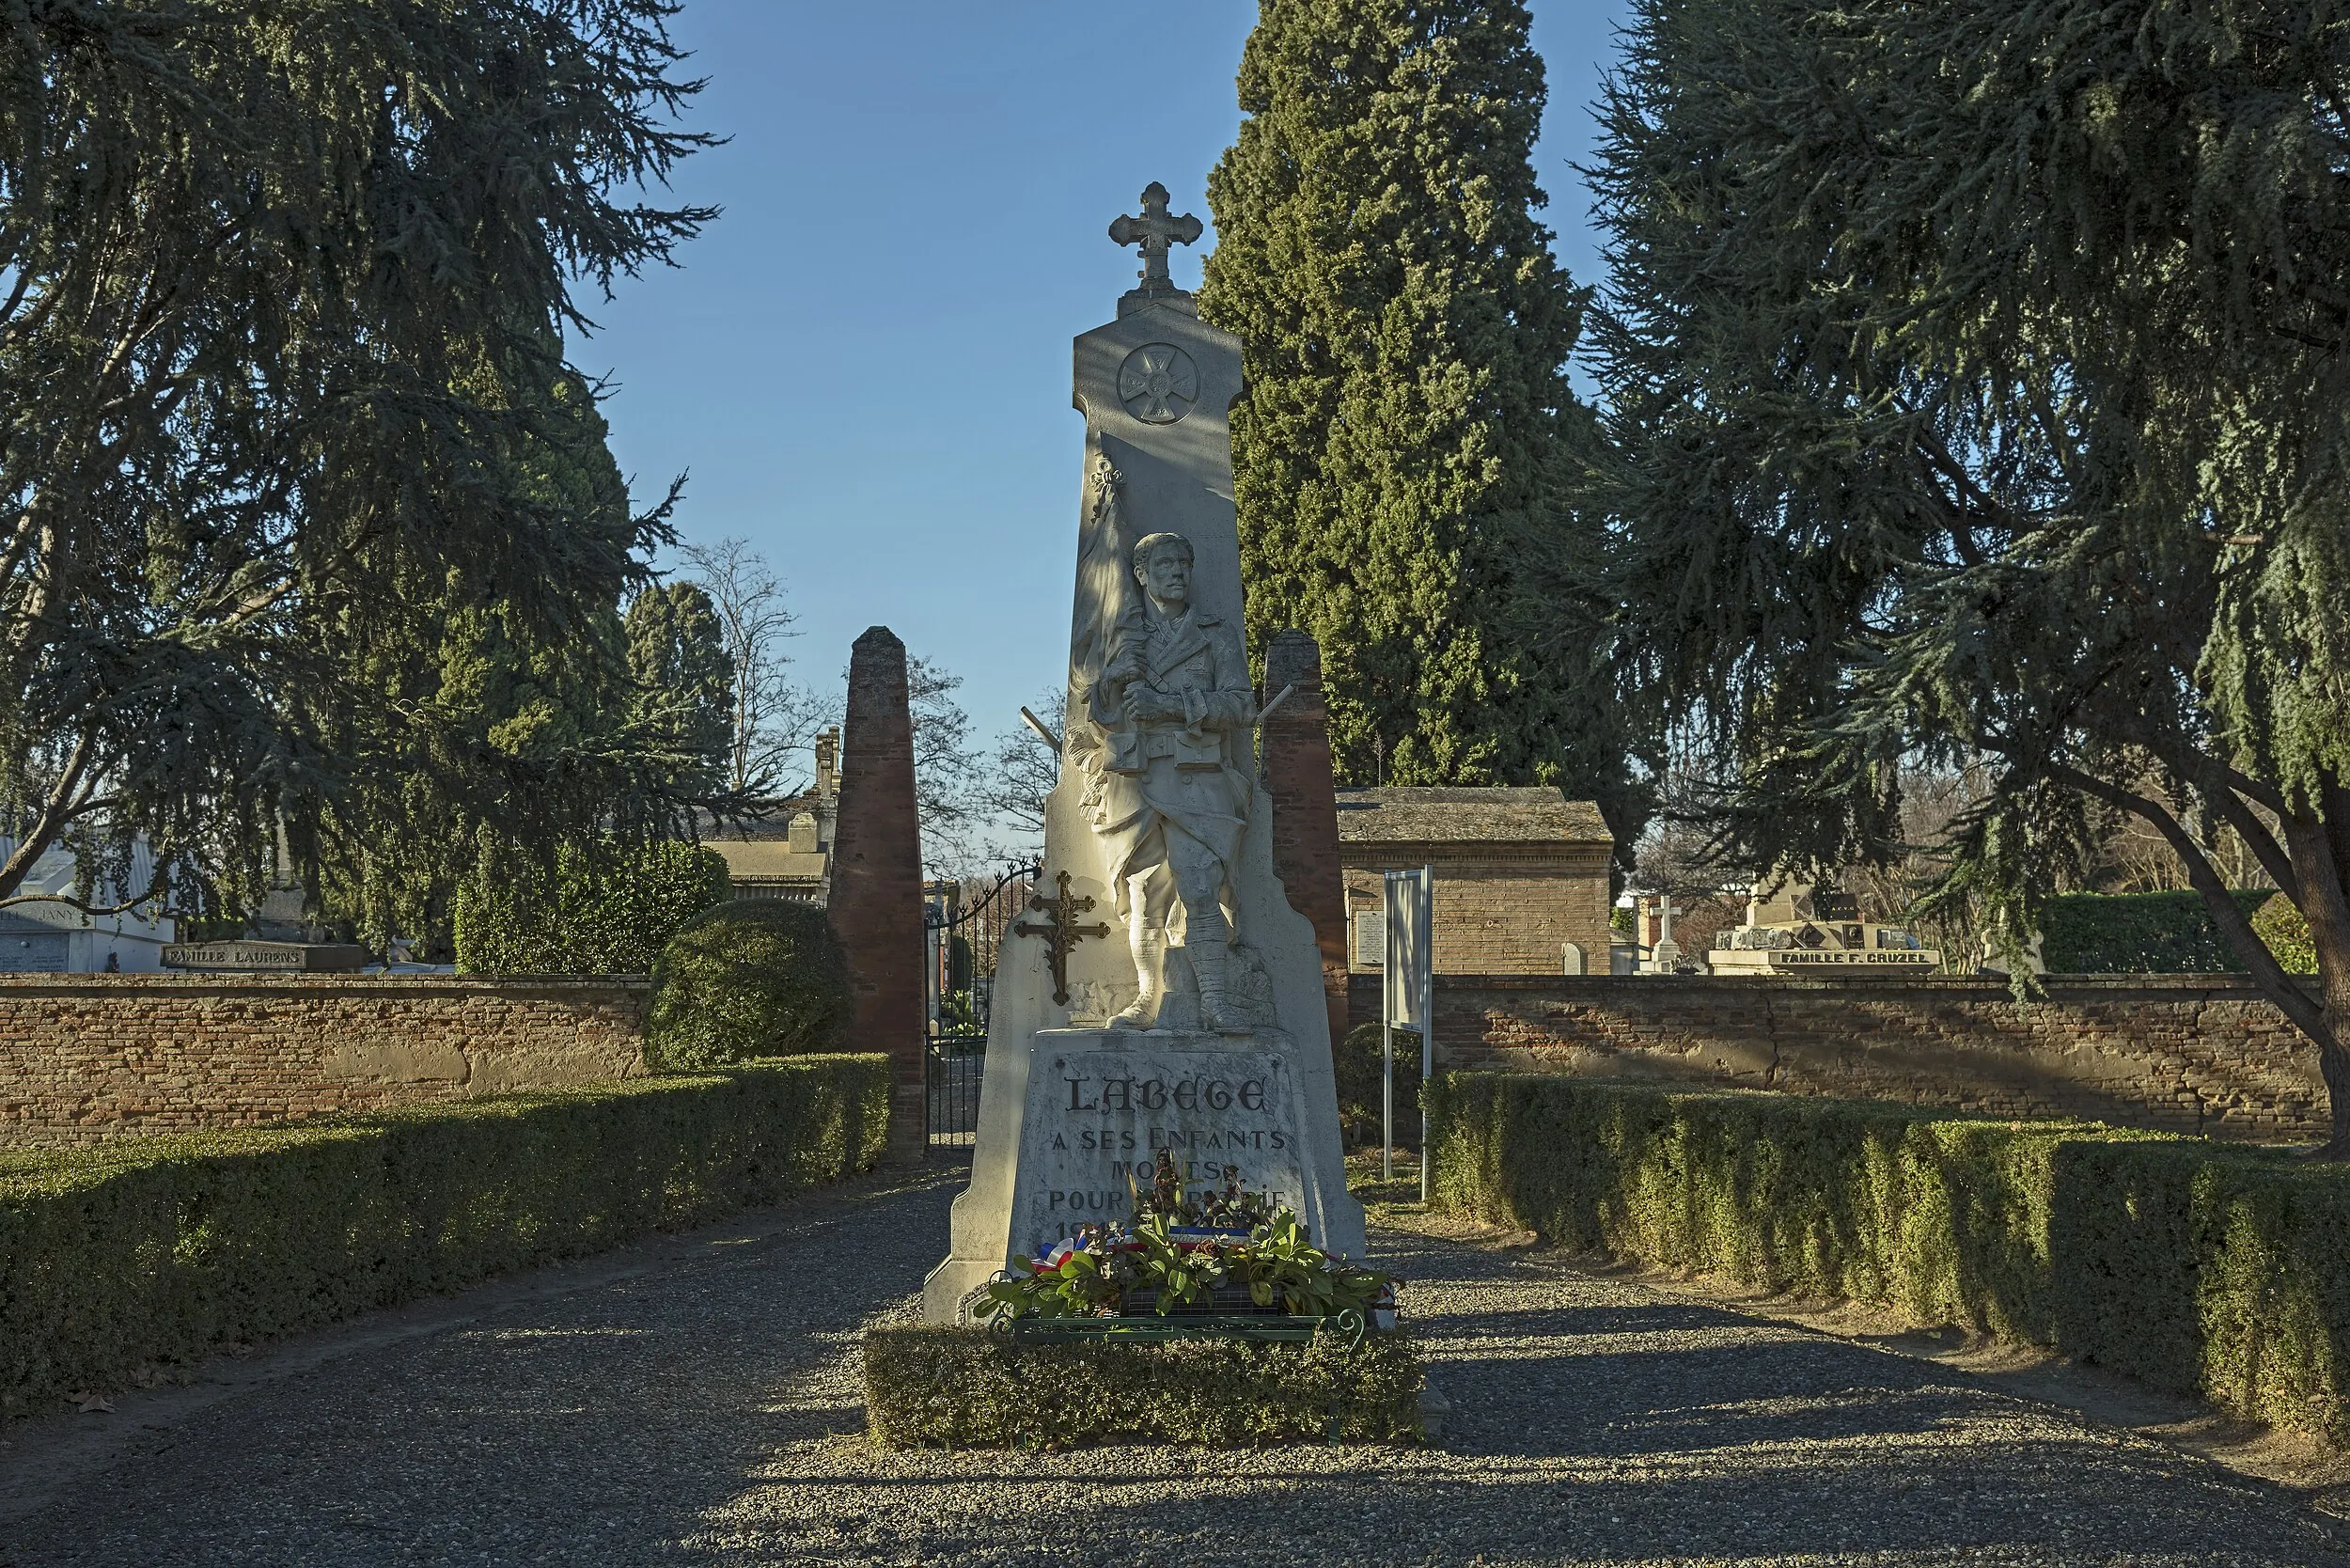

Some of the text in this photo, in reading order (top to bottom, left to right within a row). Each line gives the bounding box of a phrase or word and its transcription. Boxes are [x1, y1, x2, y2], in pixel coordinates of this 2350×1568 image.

[39, 909, 76, 921] JANY
[169, 950, 299, 964] FAMILLE LAURENS
[1780, 953, 1931, 964] FAMILLE F. CRUZEL
[1063, 1076, 1269, 1116] LABEGE
[1051, 1127, 1286, 1151] A SES ENFANTS
[1111, 1160, 1221, 1181] MOTS
[1049, 1190, 1123, 1211] POUR
